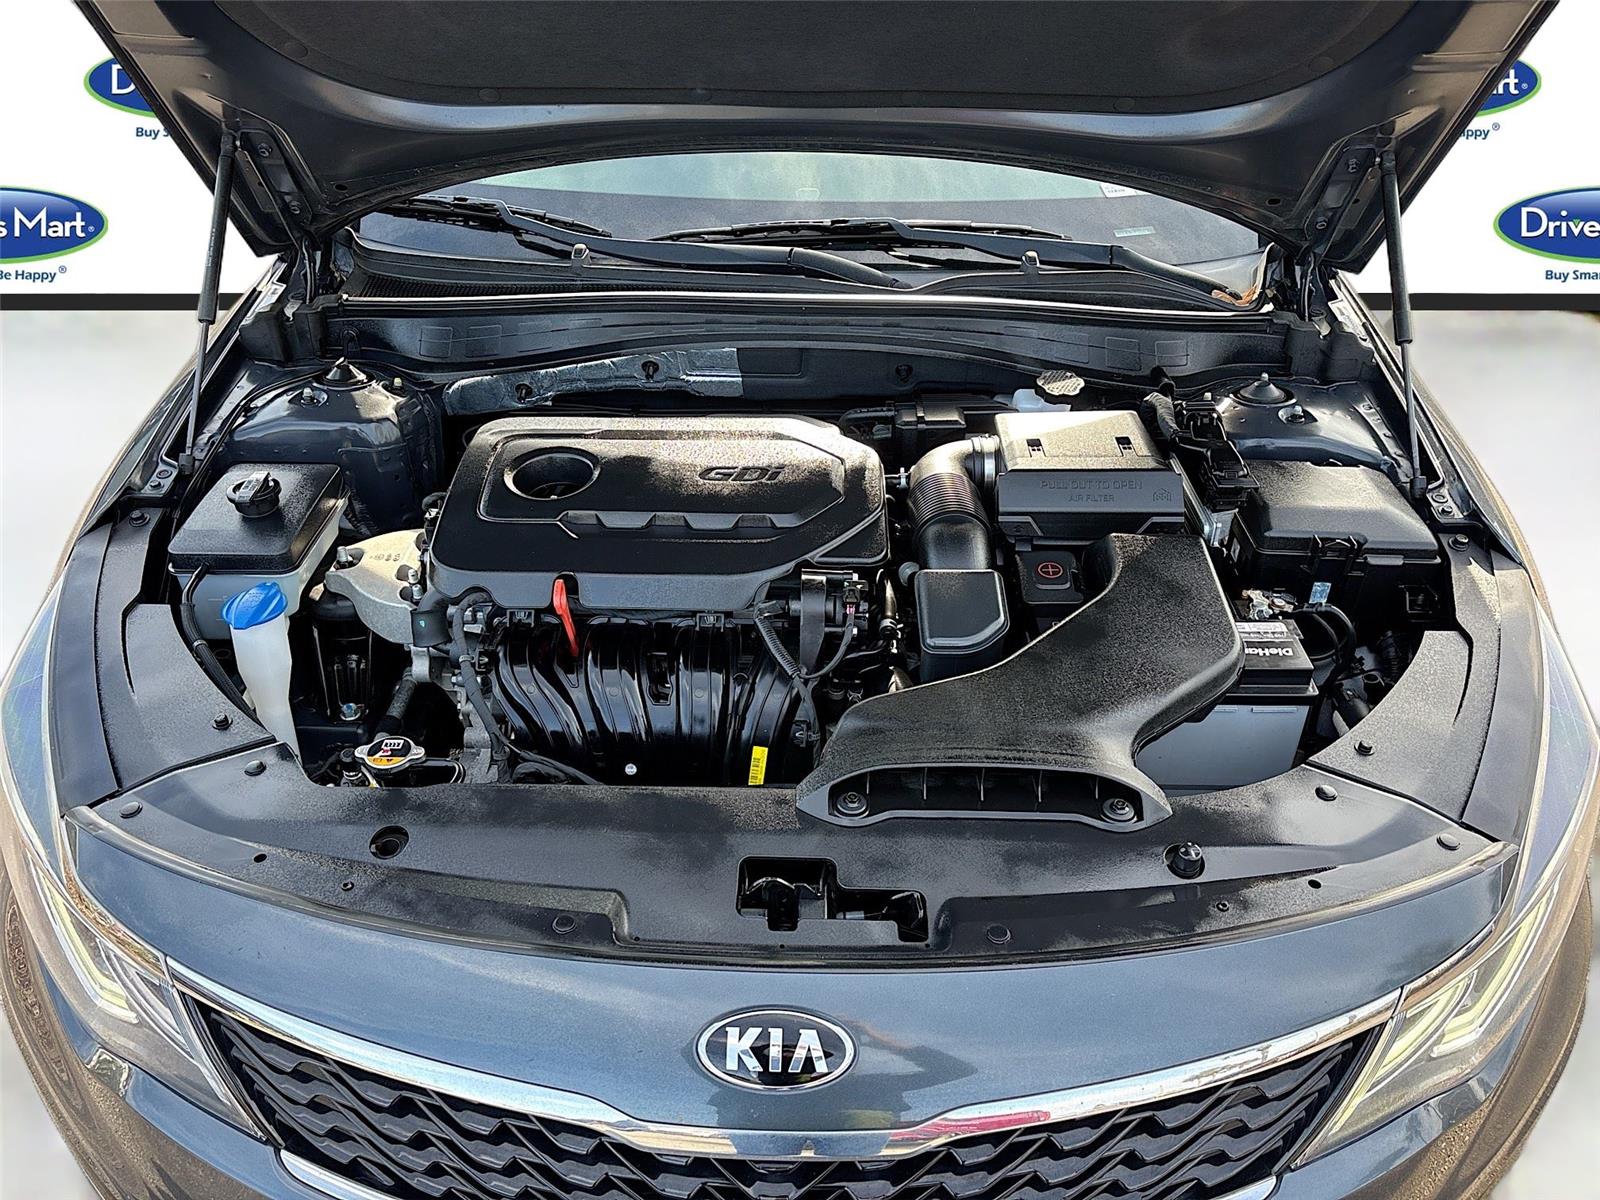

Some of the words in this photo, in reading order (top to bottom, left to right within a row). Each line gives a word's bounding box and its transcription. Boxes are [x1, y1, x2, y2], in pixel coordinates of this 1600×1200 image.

[1492, 69, 1520, 94] rt
[135, 127, 160, 140] Buy
[1461, 129, 1490, 140] ppy
[14, 206, 86, 238] Mart
[1521, 206, 1600, 238] Drive
[15, 270, 57, 283] Happy
[1545, 269, 1570, 283] Buy
[1040, 480, 1068, 490] PULL
[1071, 480, 1094, 490] OUT
[1095, 480, 1110, 490] TO
[1113, 480, 1143, 490] OPEN
[1068, 494, 1083, 502] AIR
[1086, 494, 1115, 502] FILTER
[725, 1026, 829, 1073] KIA
